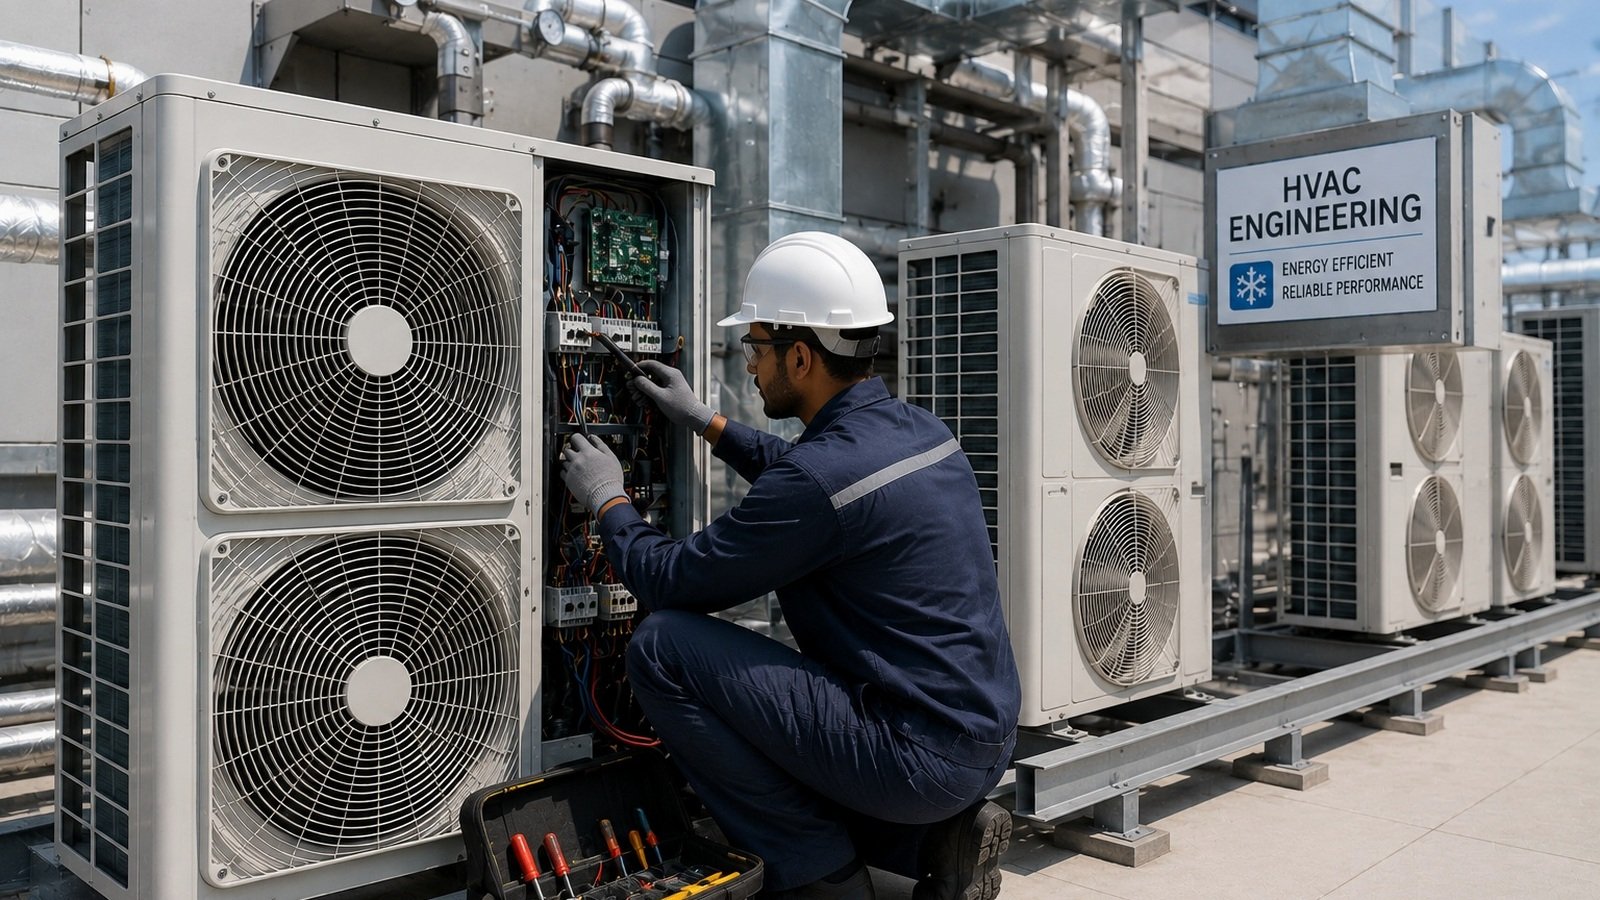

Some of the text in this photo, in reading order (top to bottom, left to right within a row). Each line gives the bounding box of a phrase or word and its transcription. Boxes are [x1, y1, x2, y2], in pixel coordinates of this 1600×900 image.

[1283, 167, 1362, 203] HVAC
[1229, 193, 1423, 243] ENGINEERING
[1282, 251, 1394, 277] ENERGY EFFICIENT
[1282, 274, 1424, 300] RELIABLE PERFORMANCE
